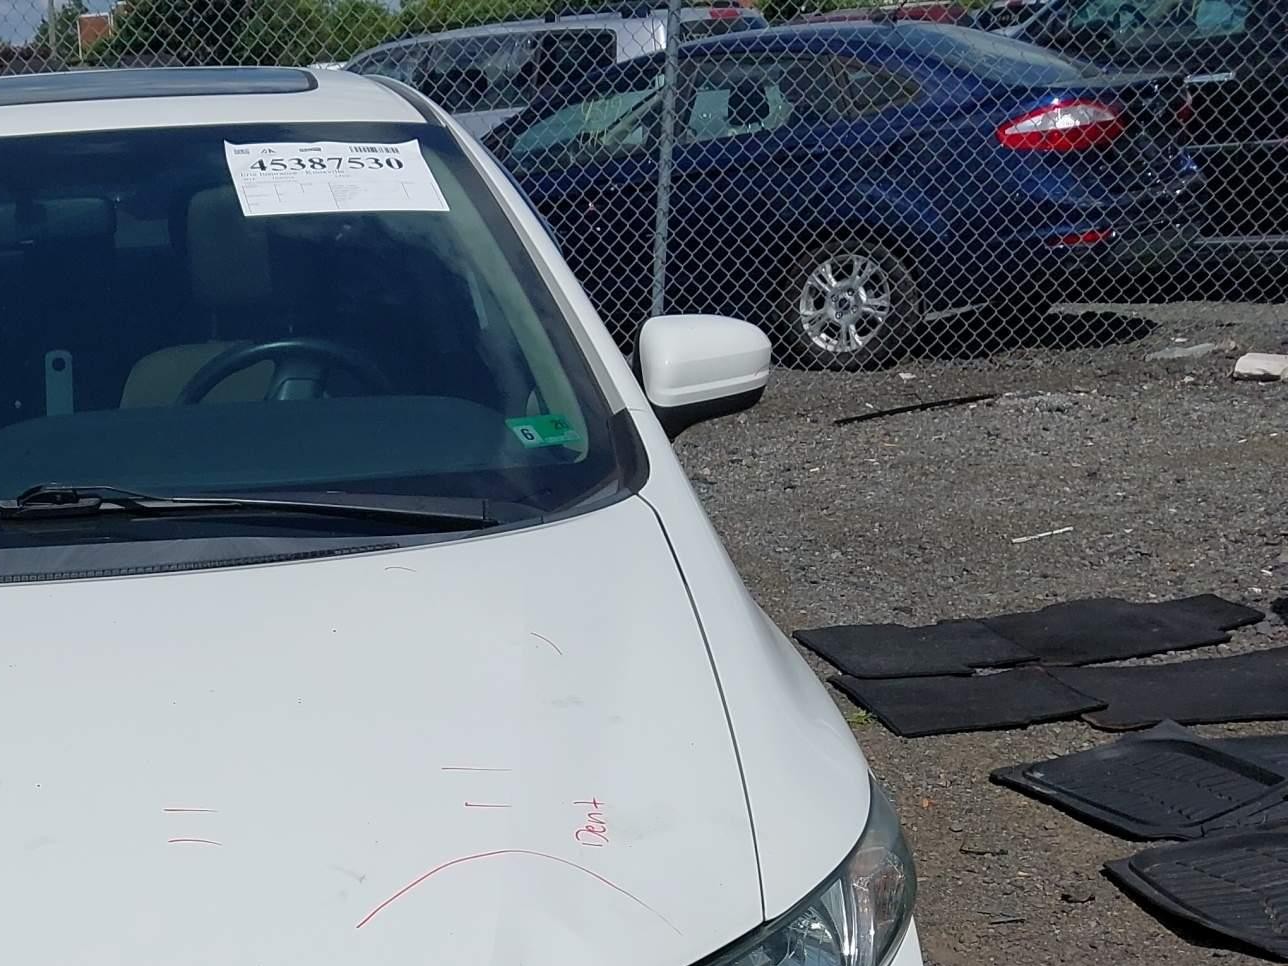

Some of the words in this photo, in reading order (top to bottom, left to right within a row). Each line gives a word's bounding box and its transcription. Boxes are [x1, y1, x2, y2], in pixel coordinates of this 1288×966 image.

[249, 157, 404, 172] 45387530
[520, 428, 536, 441] 6
[573, 796, 610, 848] Dent
